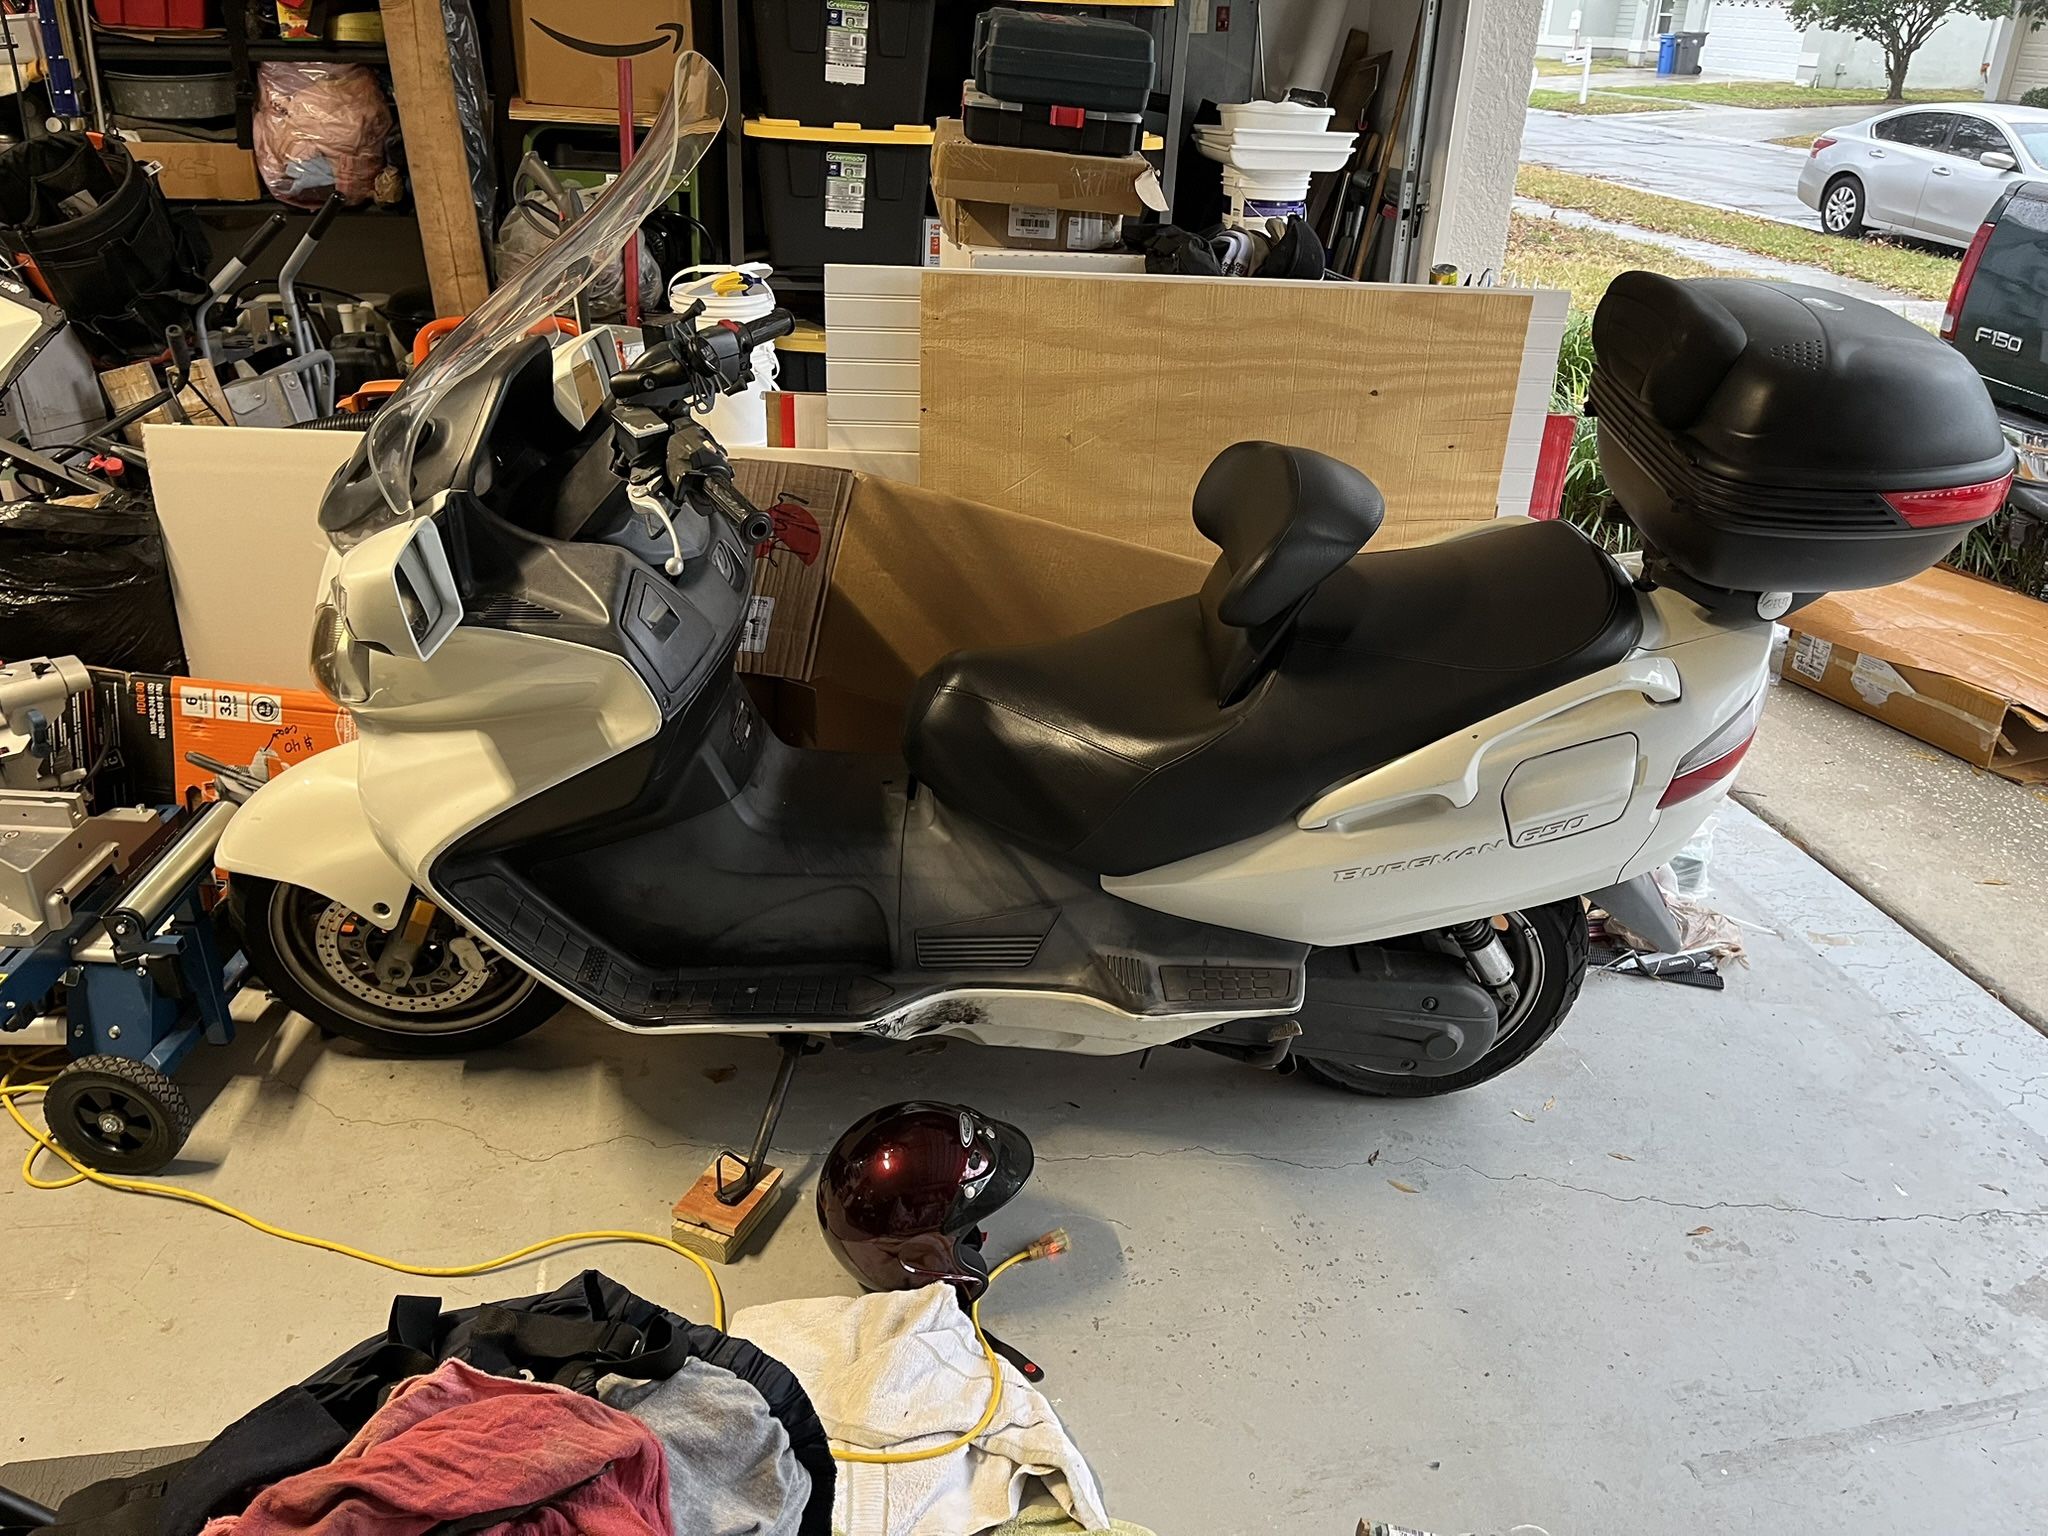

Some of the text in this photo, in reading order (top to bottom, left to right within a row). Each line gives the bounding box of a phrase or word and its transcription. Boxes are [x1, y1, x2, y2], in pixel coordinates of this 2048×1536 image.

[186, 696, 197, 706] 6
[219, 695, 231, 716] 3.5
[1334, 813, 1589, 883] BURGMAN 650
